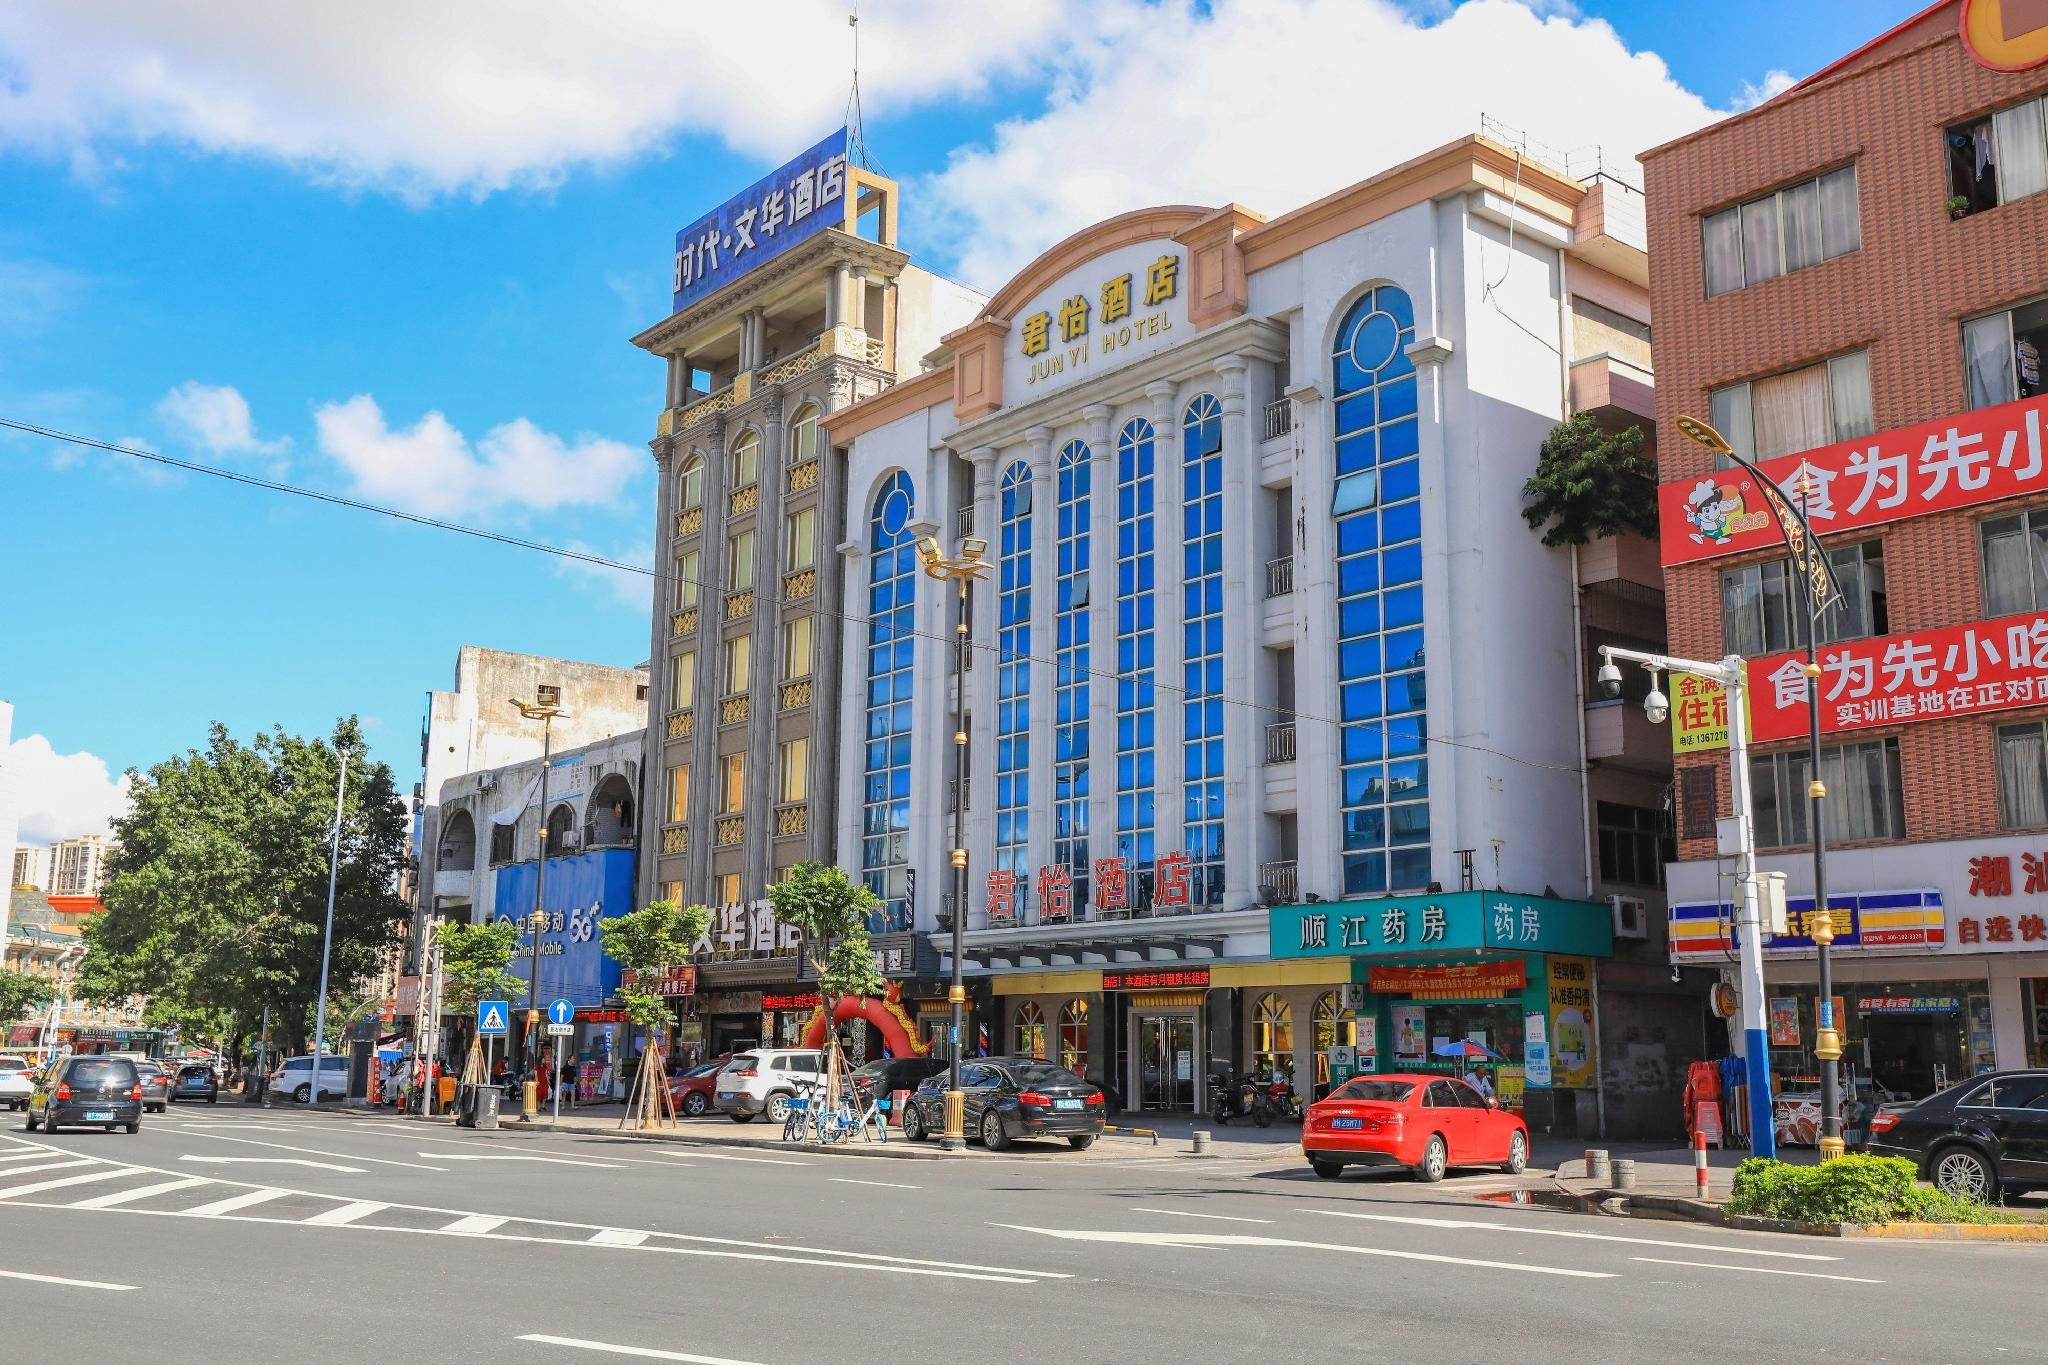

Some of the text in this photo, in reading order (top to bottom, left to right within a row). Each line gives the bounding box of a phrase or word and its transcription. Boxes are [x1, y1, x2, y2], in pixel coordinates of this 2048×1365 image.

[673, 153, 847, 295] 时代·文华酒店
[1021, 255, 1179, 358] 君怡酒店
[1027, 312, 1172, 385] JUN YI HOTEL
[1777, 409, 2048, 520] 食为先小
[1679, 674, 1727, 698] 金满
[1767, 619, 2048, 710] 食为先小吃
[985, 851, 1191, 916] 君怡酒店
[1300, 905, 1447, 949] 顺江药房
[1494, 903, 1541, 942] 药房
[1958, 914, 2047, 944] 自选快
